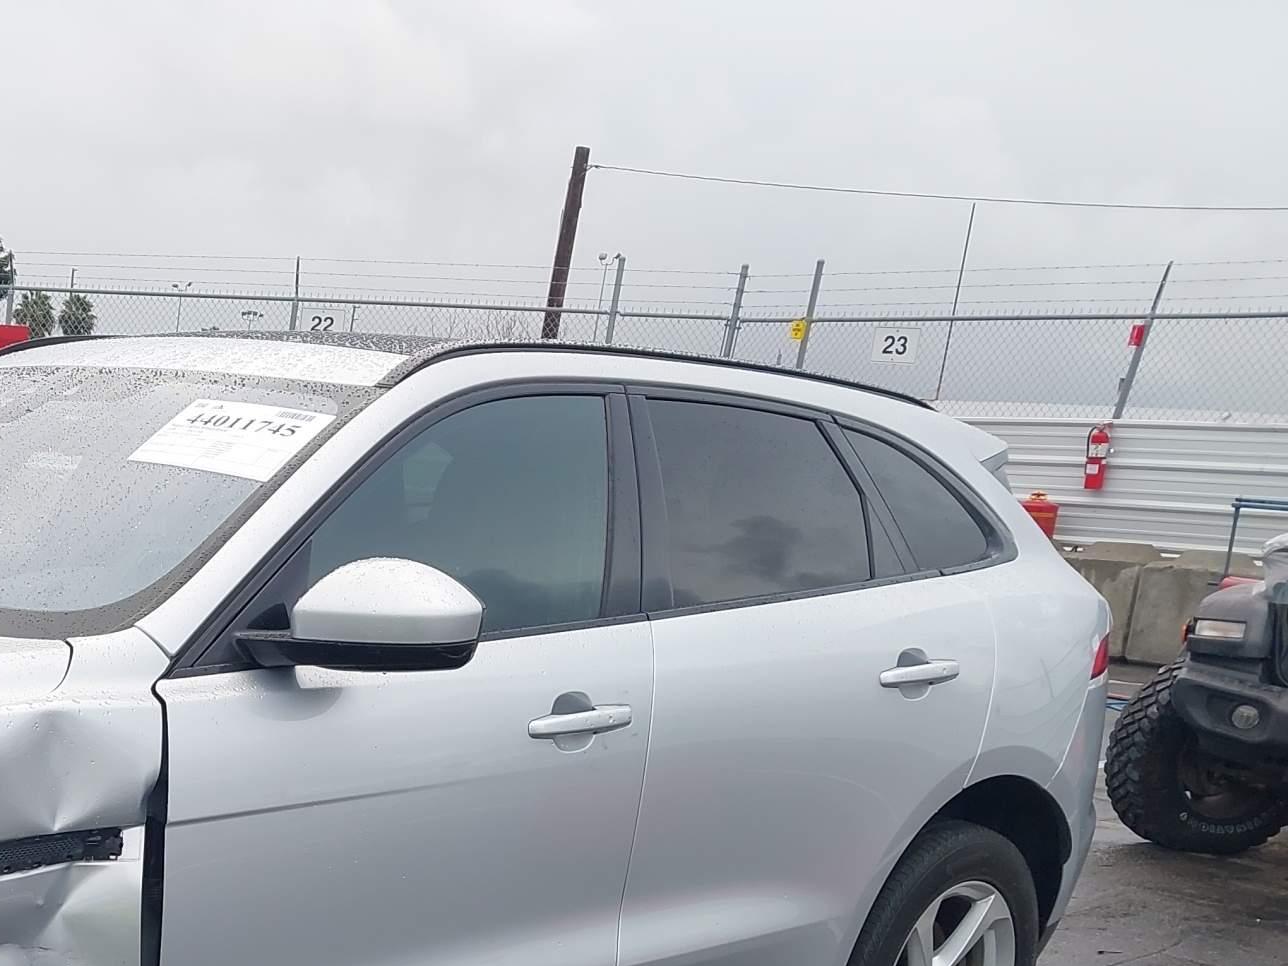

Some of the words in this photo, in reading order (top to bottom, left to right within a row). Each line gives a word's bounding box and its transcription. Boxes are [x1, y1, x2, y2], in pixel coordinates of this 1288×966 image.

[310, 315, 335, 331] 22
[882, 335, 908, 355] 23
[186, 412, 302, 437] 44011745
